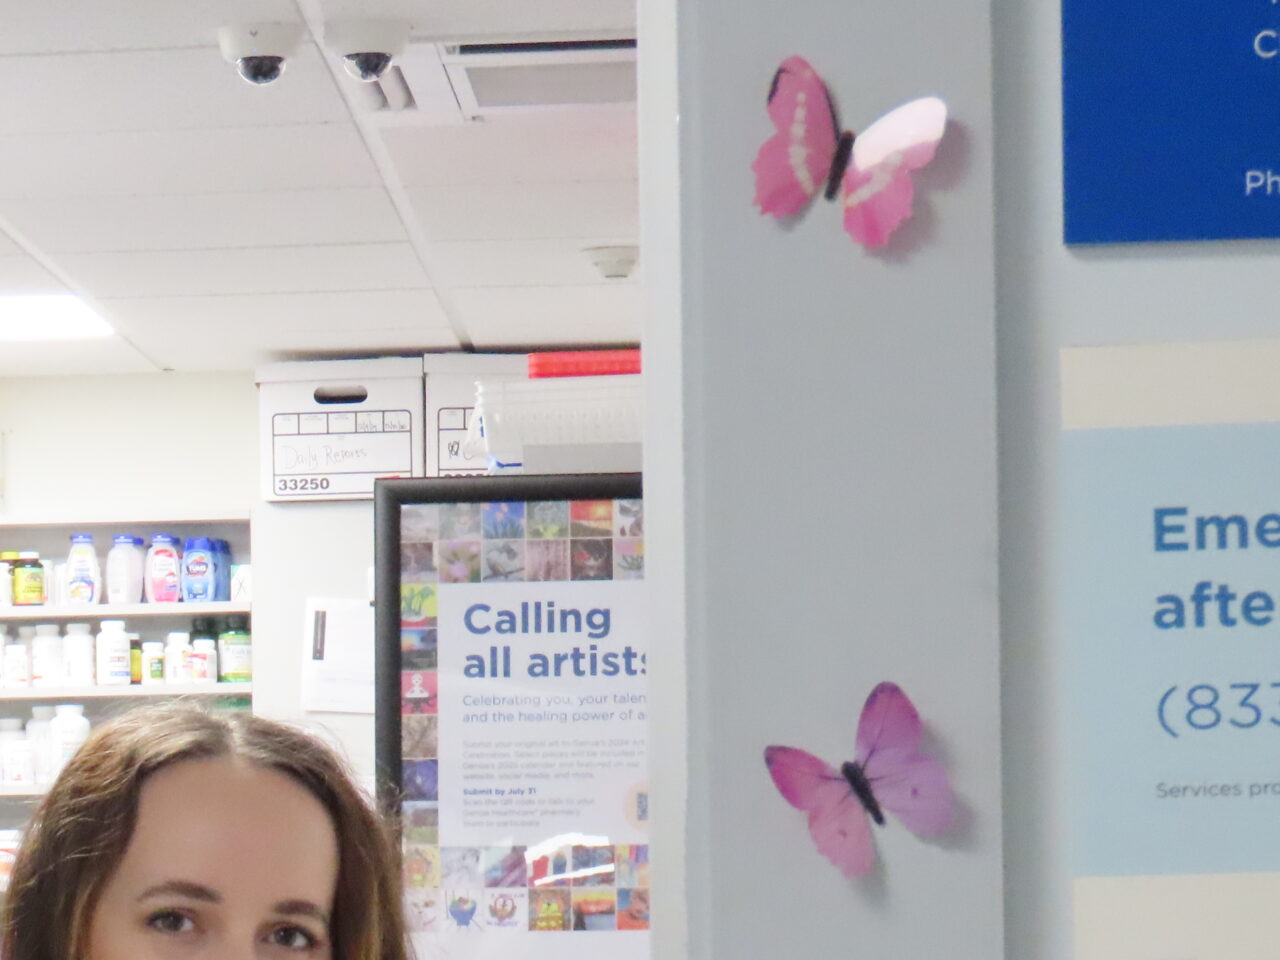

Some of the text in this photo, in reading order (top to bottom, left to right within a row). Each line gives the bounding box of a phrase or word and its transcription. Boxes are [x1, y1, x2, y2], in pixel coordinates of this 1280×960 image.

[278, 477, 330, 491] 33250
[1154, 506, 1280, 552] Eme
[1153, 581, 1275, 630] afte
[464, 601, 611, 639] Calling
[463, 646, 511, 678] all
[463, 695, 542, 708] Celebrating
[579, 694, 609, 706] your
[463, 711, 489, 723] and
[492, 711, 514, 722] the
[518, 710, 568, 723] healing
[572, 711, 615, 723] power
[619, 709, 633, 721] of
[1155, 782, 1280, 800] Services pro
